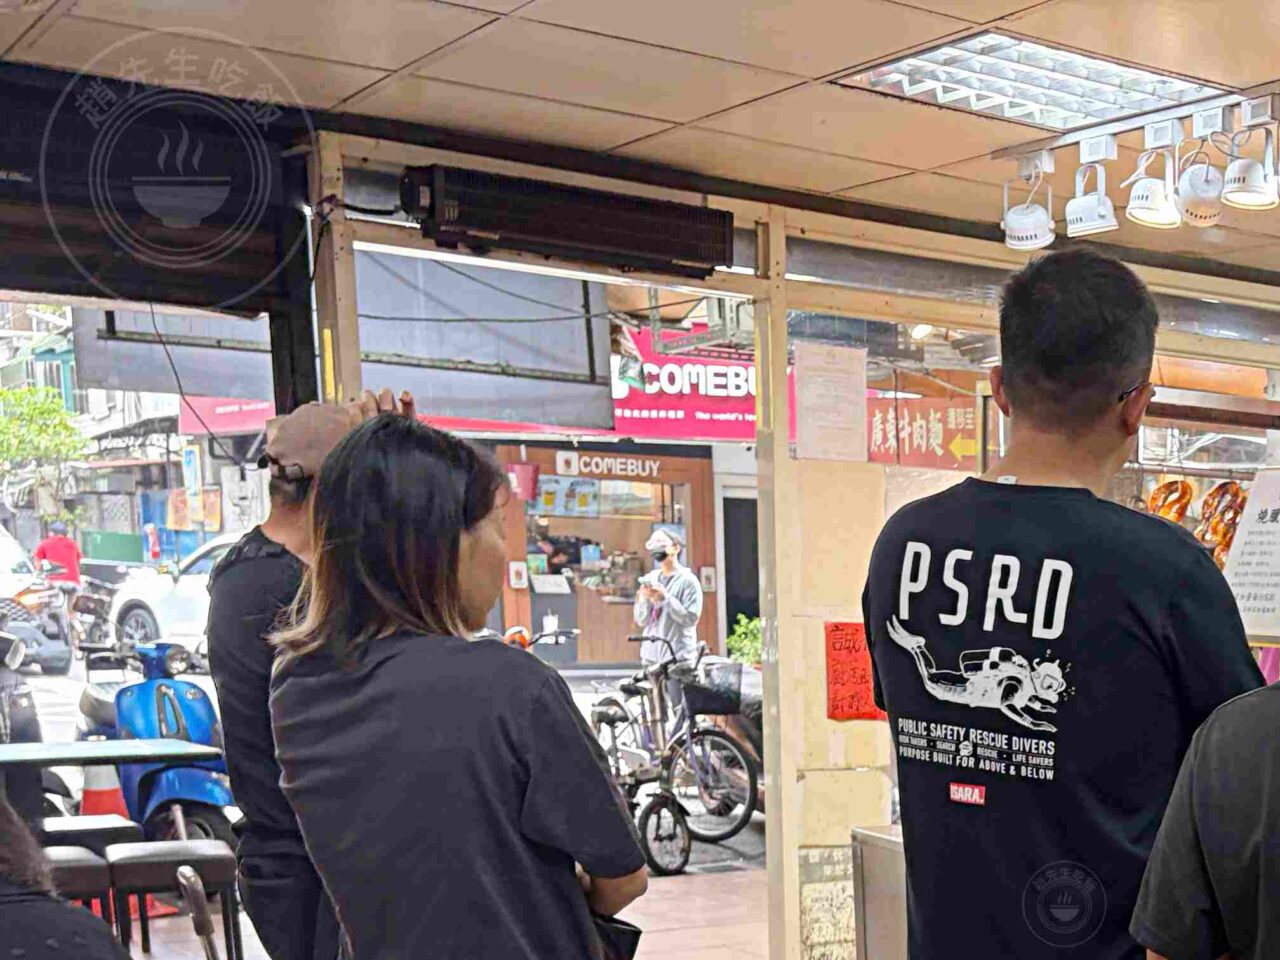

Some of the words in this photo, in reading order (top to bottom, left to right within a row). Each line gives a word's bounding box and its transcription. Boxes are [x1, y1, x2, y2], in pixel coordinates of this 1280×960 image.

[579, 456, 660, 477] COMEBUY
[900, 541, 1074, 640] PSRD
[898, 718, 927, 736] PUBLIC
[930, 723, 966, 741] SAFETY
[969, 728, 1008, 749] RESCUE
[1012, 736, 1055, 755] DIVERS
[899, 745, 930, 761] PURPOSE
[933, 750, 953, 765] BUILT
[956, 756, 975, 769] FOR
[979, 759, 1006, 774] ABOVE
[1009, 766, 1016, 775] &
[1021, 766, 1054, 781] BELOW
[976, 746, 998, 758] RESCUE
[1012, 753, 1026, 763] LIFE
[1028, 755, 1054, 767] SAVERS
